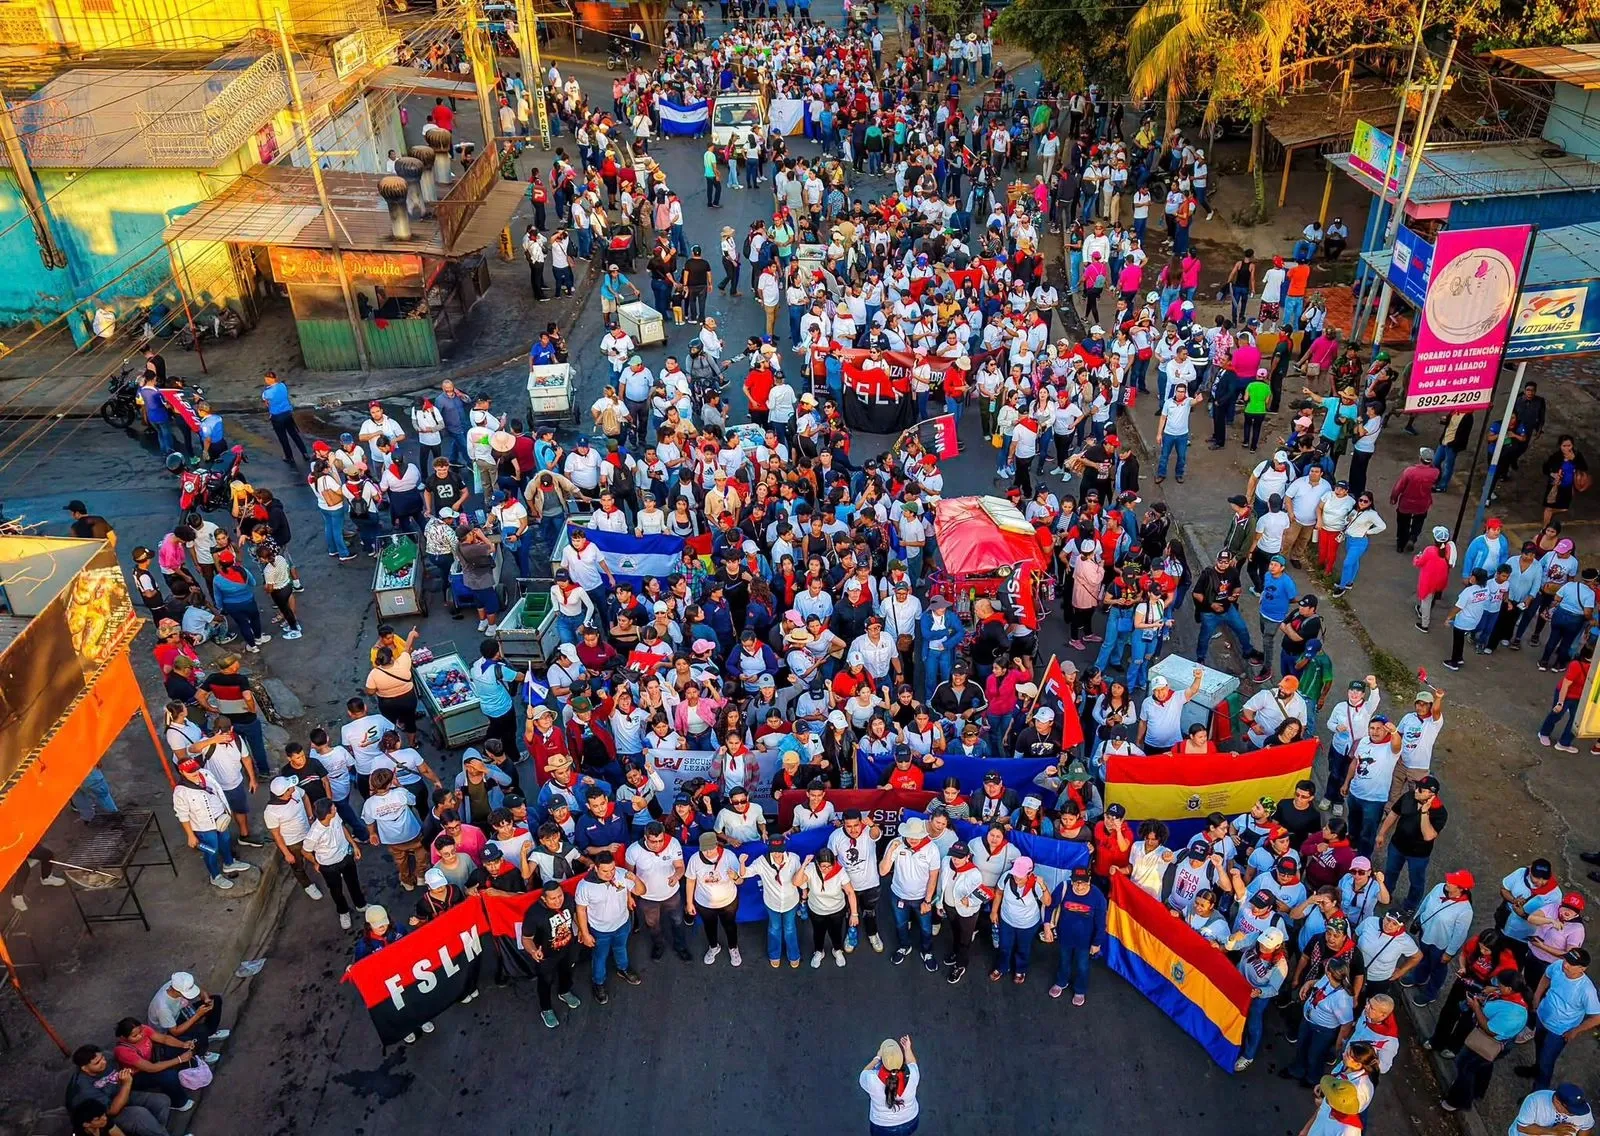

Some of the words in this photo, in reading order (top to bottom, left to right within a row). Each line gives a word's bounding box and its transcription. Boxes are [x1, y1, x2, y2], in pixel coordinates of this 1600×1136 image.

[540, 112, 550, 149] PARTES
[1513, 320, 1574, 335] MOTOMÁS
[1417, 350, 1450, 361] HORARIO
[1452, 349, 1462, 358] DE
[1424, 364, 1447, 374] LUNES
[1448, 363, 1453, 372] A
[1454, 360, 1488, 372] SÁBADOS
[1418, 381, 1434, 389] 9:00
[1435, 379, 1447, 387] AM
[1469, 375, 1480, 384] PM
[1417, 391, 1481, 408] 8992-4209
[436, 484, 454, 498] 23
[1007, 567, 1027, 618] FSLN
[1179, 868, 1200, 885] FSLN
[1187, 883, 1197, 893] 19
[1184, 890, 1195, 901] 79
[384, 924, 483, 1011] FSLN
